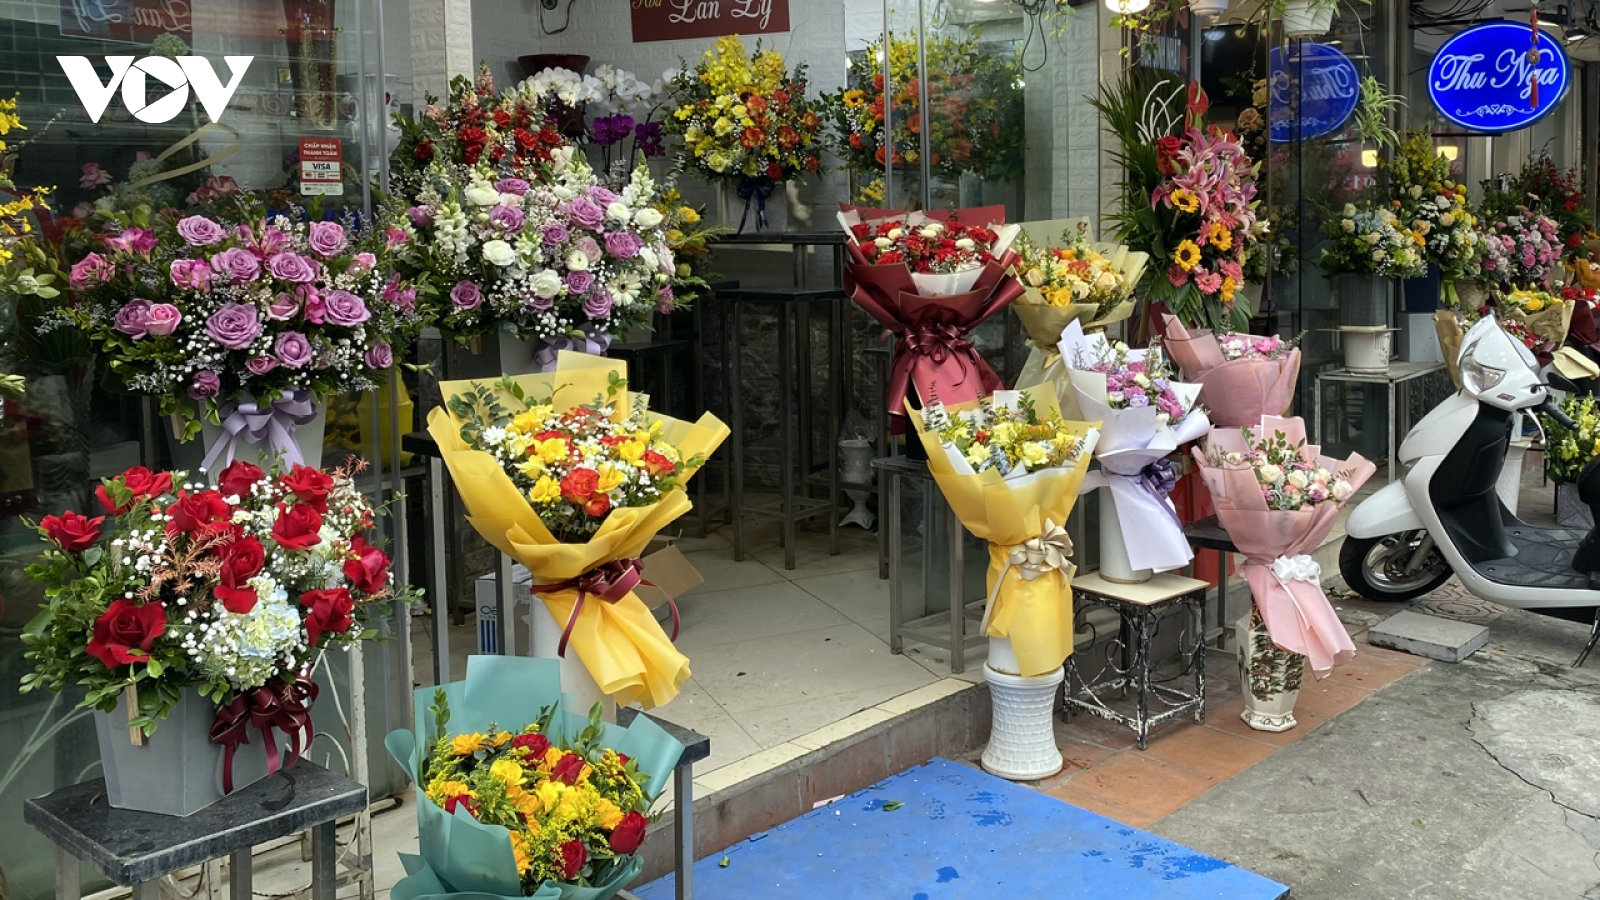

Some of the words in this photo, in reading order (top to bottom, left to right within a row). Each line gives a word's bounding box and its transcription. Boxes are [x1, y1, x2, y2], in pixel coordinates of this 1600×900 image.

[669, 0, 720, 23] Lan
[1434, 53, 1487, 91] Thu
[1490, 48, 1560, 99] Nga
